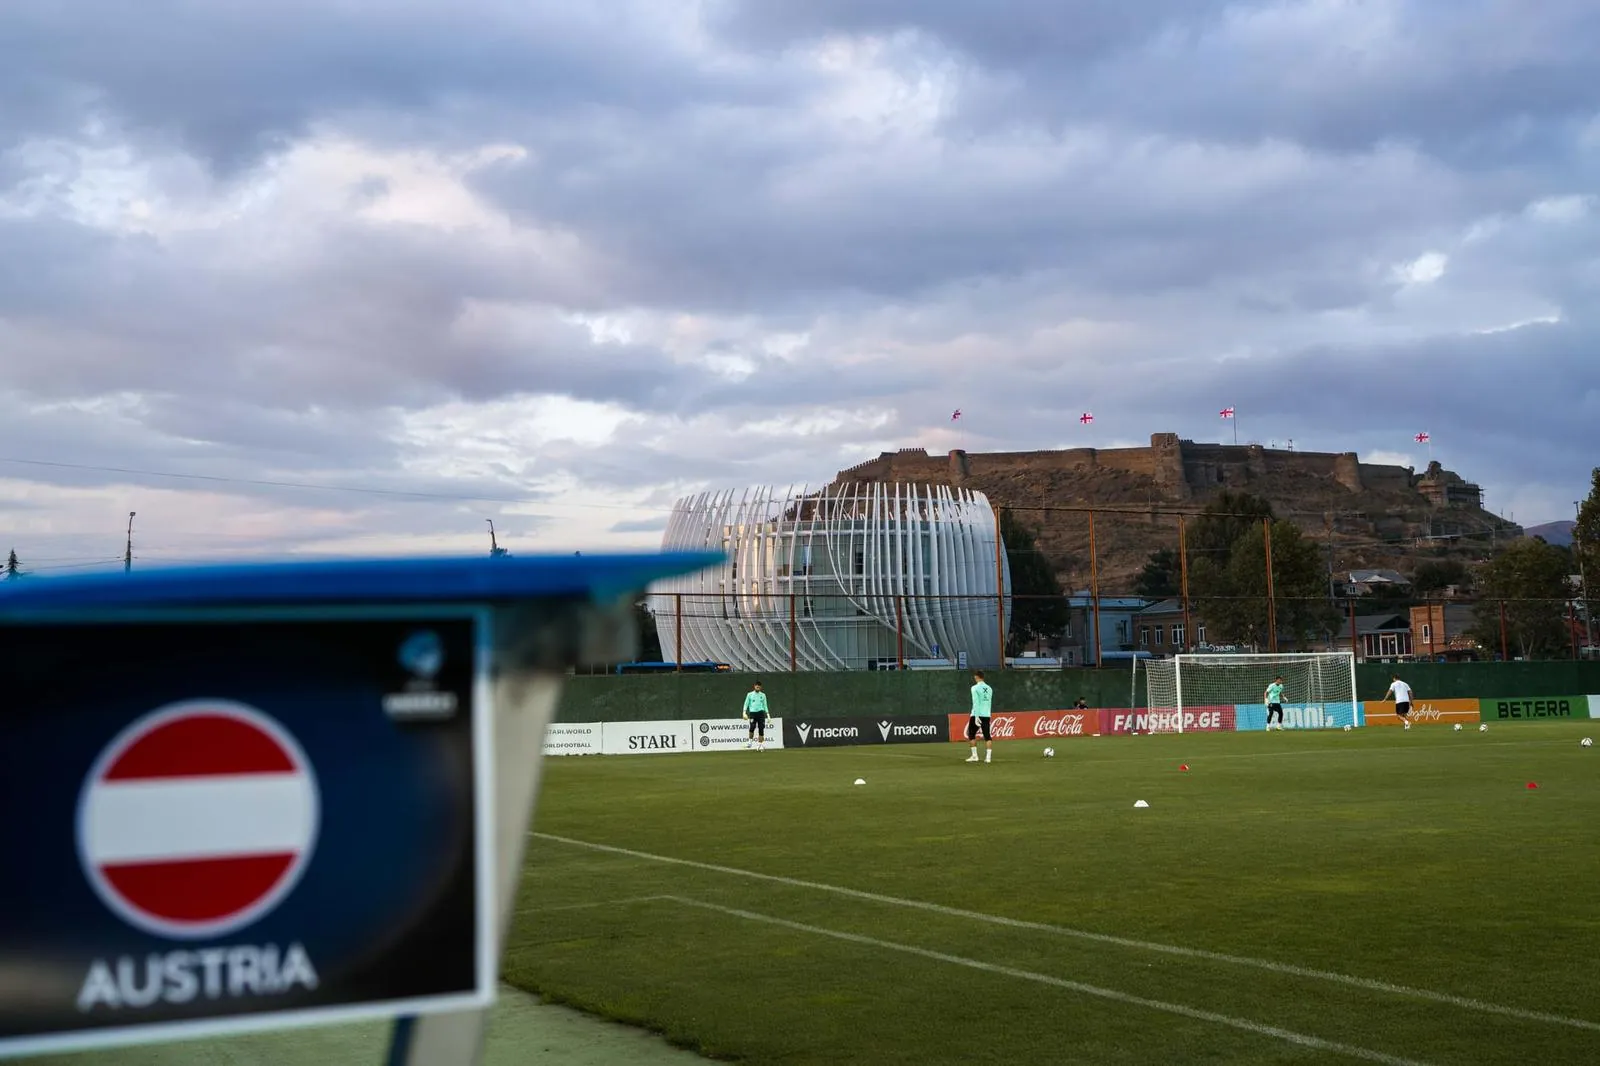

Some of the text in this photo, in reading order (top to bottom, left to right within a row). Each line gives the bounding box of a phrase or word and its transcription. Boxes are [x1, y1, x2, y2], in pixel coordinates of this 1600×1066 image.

[894, 725, 937, 735] macron
[1034, 714, 1084, 736] Coca-Cola
[1114, 712, 1221, 731] FANSHOP.GE
[813, 727, 858, 738] macron
[629, 734, 676, 749] STARI
[77, 941, 320, 1013] AUSTRIA
